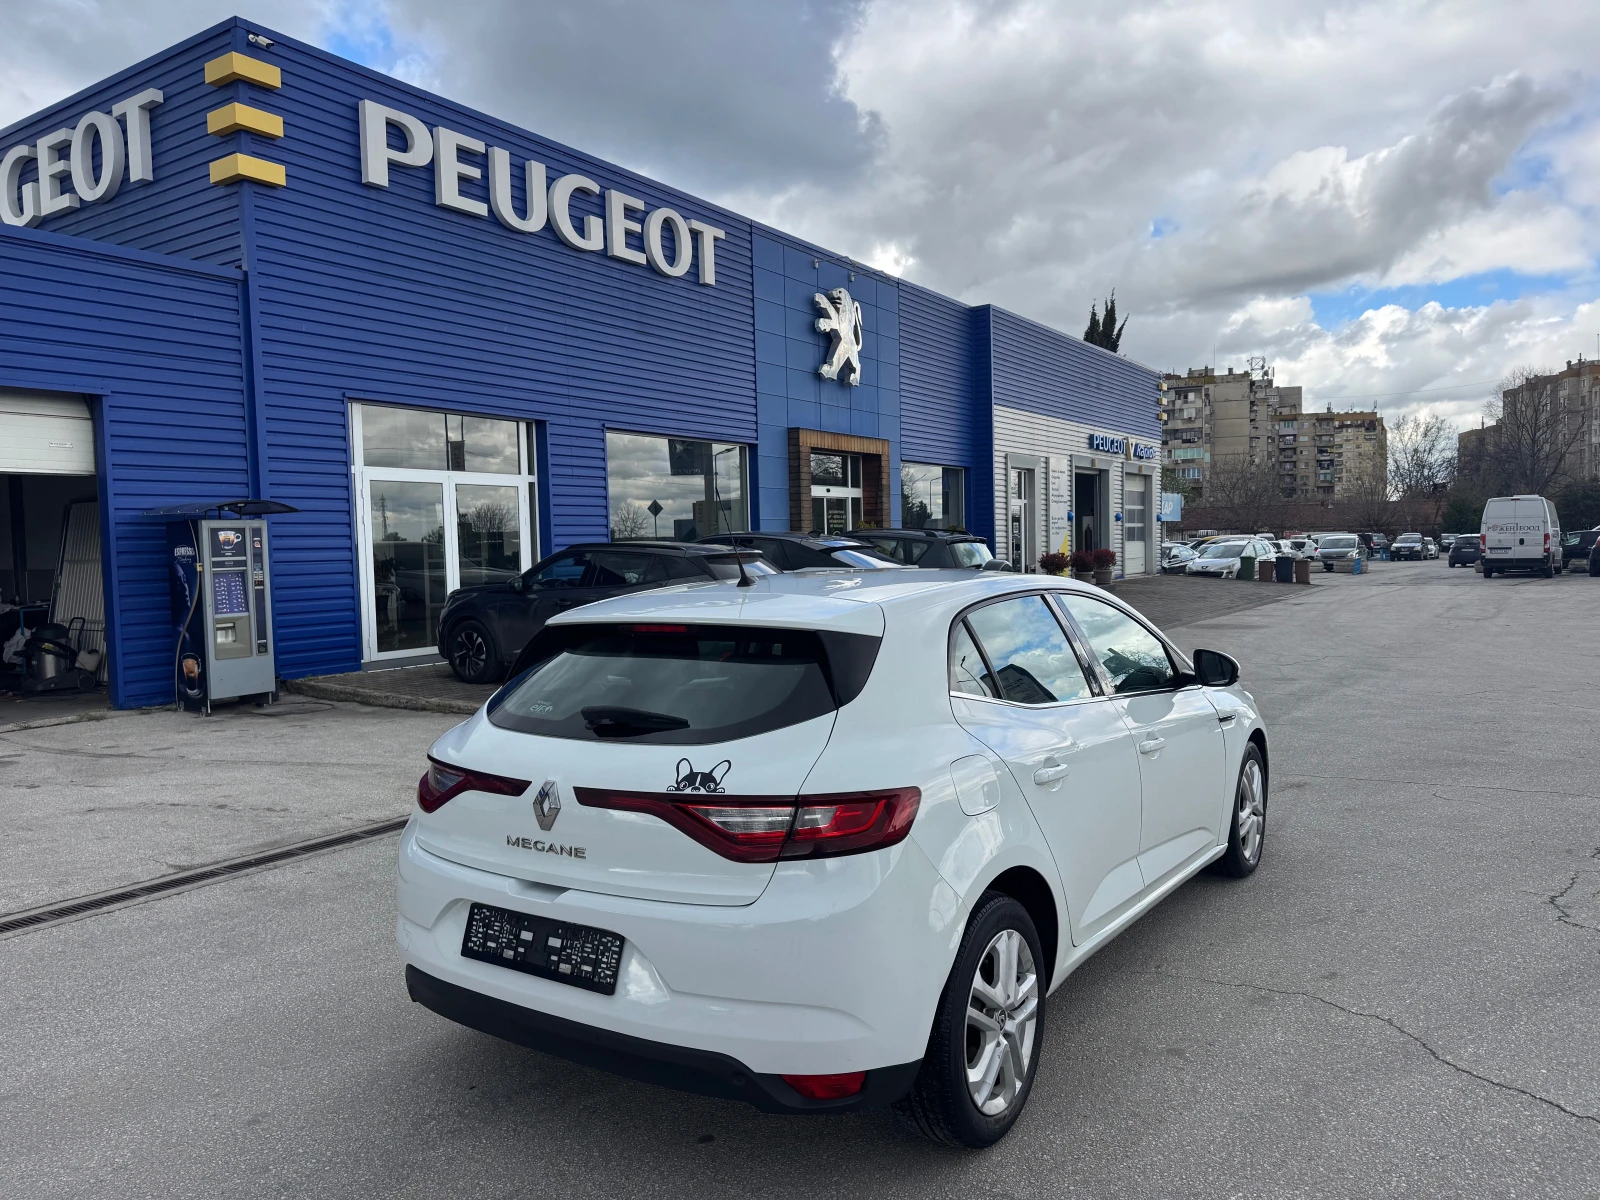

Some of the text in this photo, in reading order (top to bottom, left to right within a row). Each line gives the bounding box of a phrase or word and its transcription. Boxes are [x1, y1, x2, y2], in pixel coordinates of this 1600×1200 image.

[0, 88, 164, 229] GEOT
[358, 98, 726, 287] PEUGEOT
[1093, 434, 1127, 454] PEUGEOT
[507, 834, 587, 859] MEGANE
